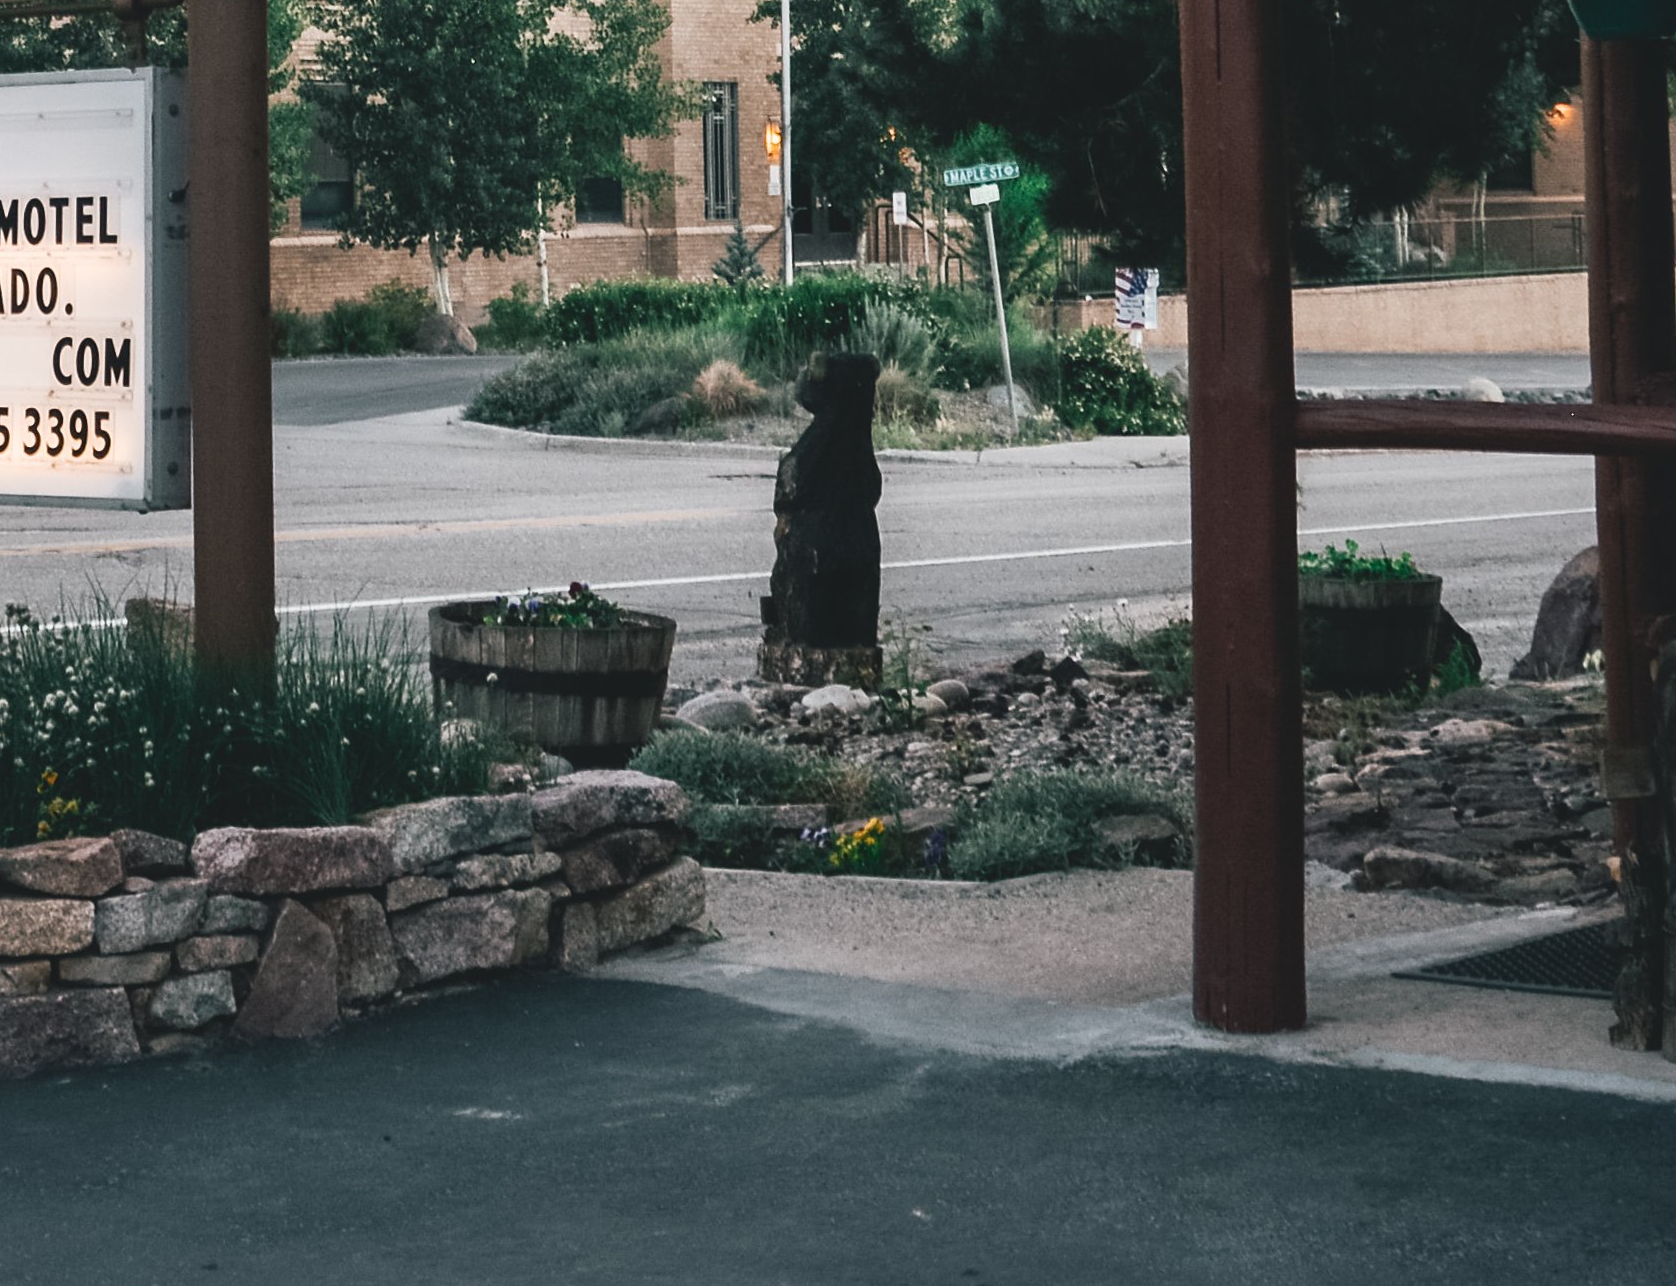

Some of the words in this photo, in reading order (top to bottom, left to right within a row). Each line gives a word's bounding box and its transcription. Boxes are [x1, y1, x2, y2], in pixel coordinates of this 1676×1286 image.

[951, 167, 986, 182] MAPLE
[990, 165, 1002, 178] ST
[52, 336, 132, 388] COM
[23, 407, 113, 460] 3395
